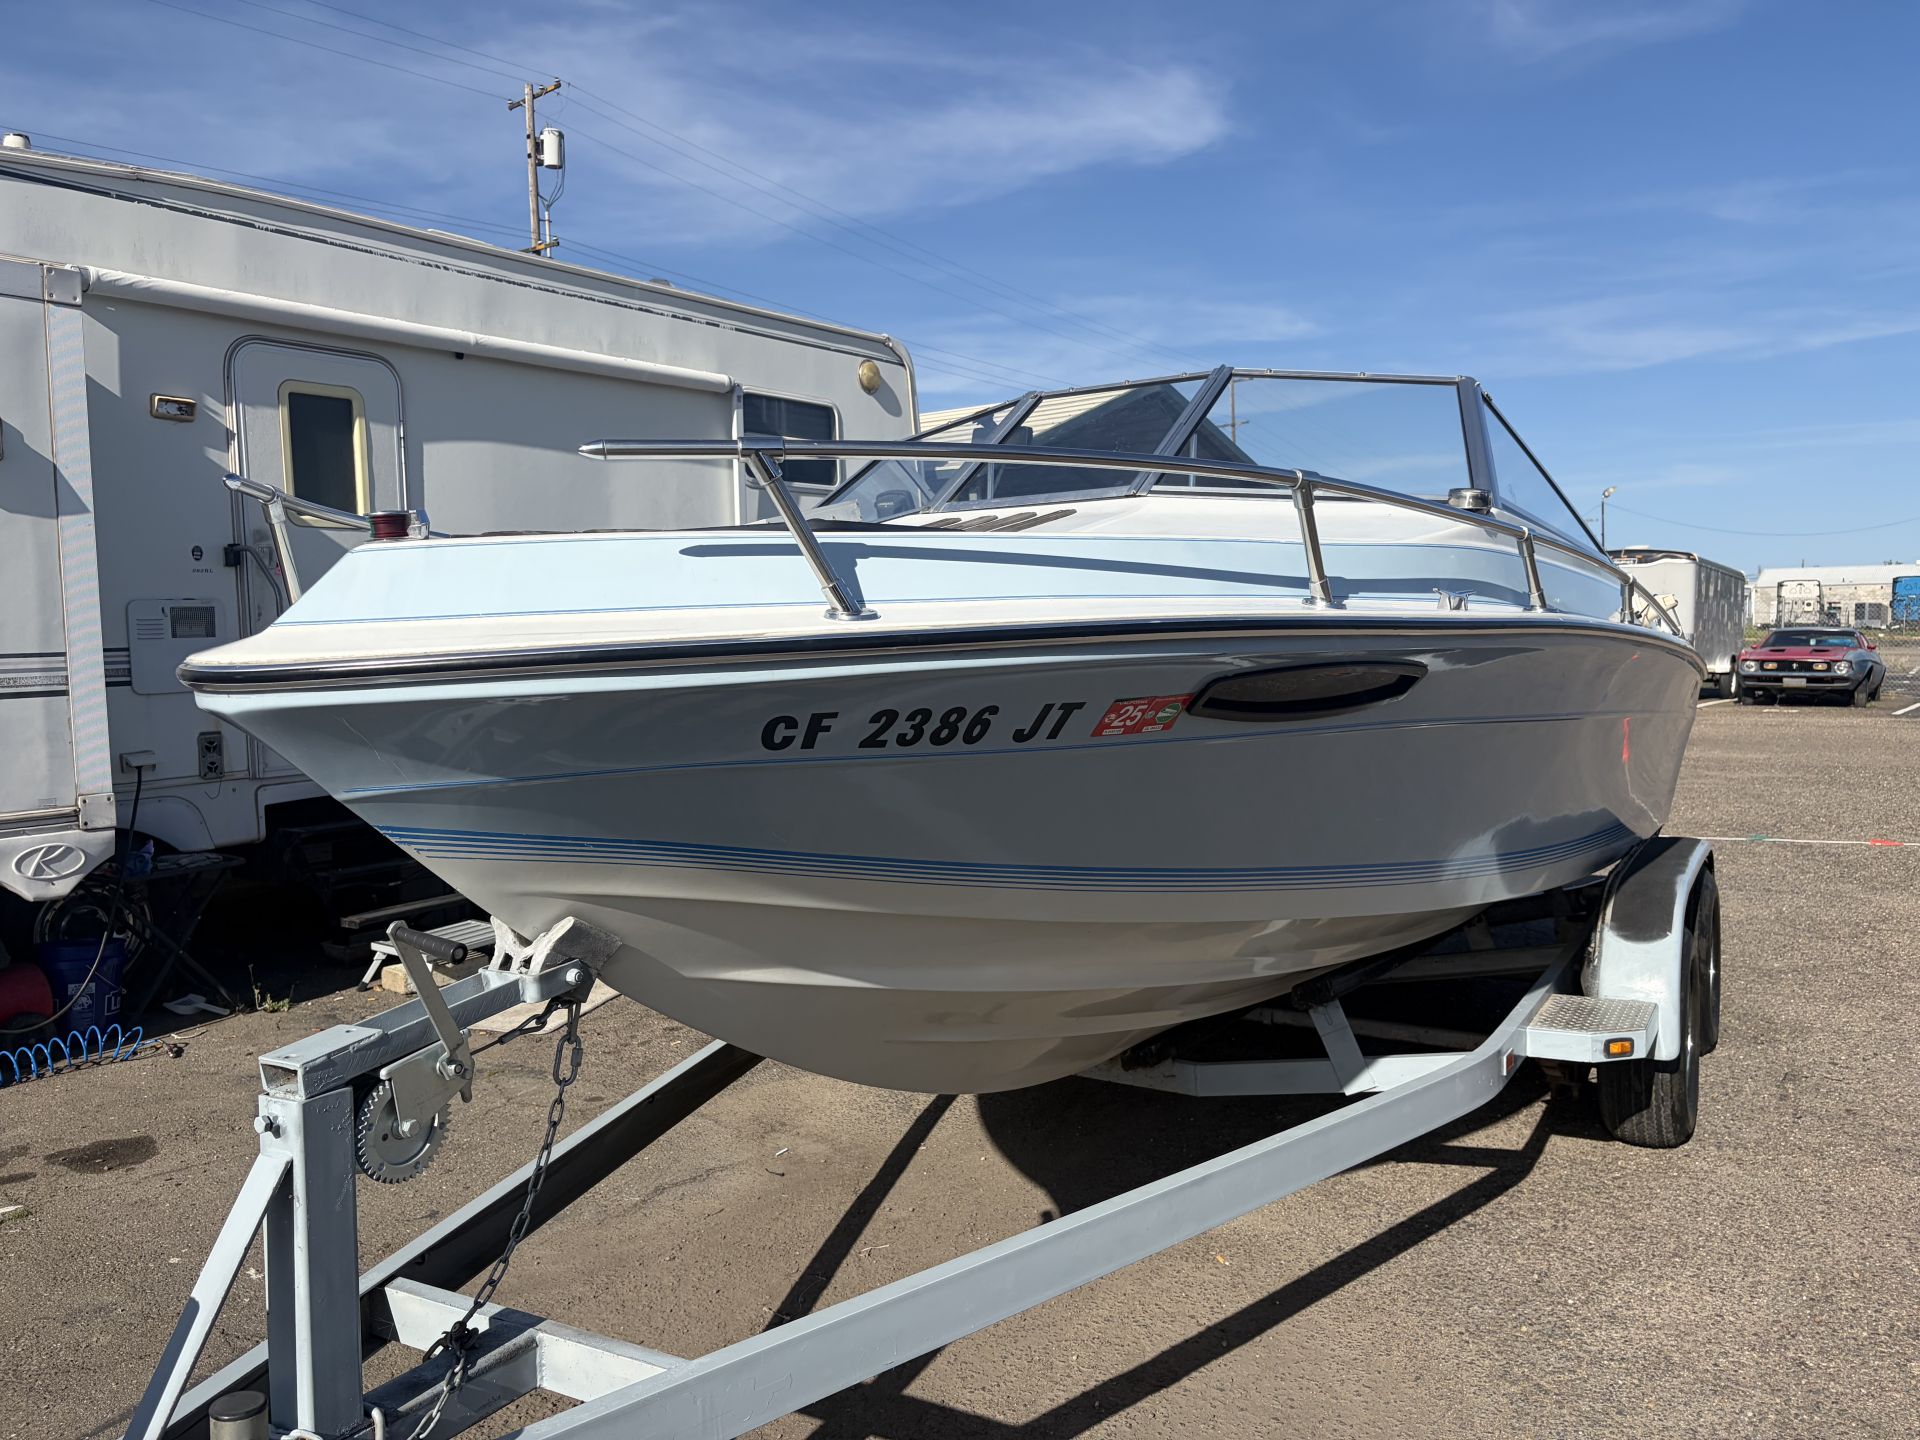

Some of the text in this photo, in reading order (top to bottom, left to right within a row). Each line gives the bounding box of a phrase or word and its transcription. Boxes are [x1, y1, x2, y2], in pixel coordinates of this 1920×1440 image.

[760, 701, 1086, 751] CF 2386 JT
[1110, 705, 1149, 726] 25
